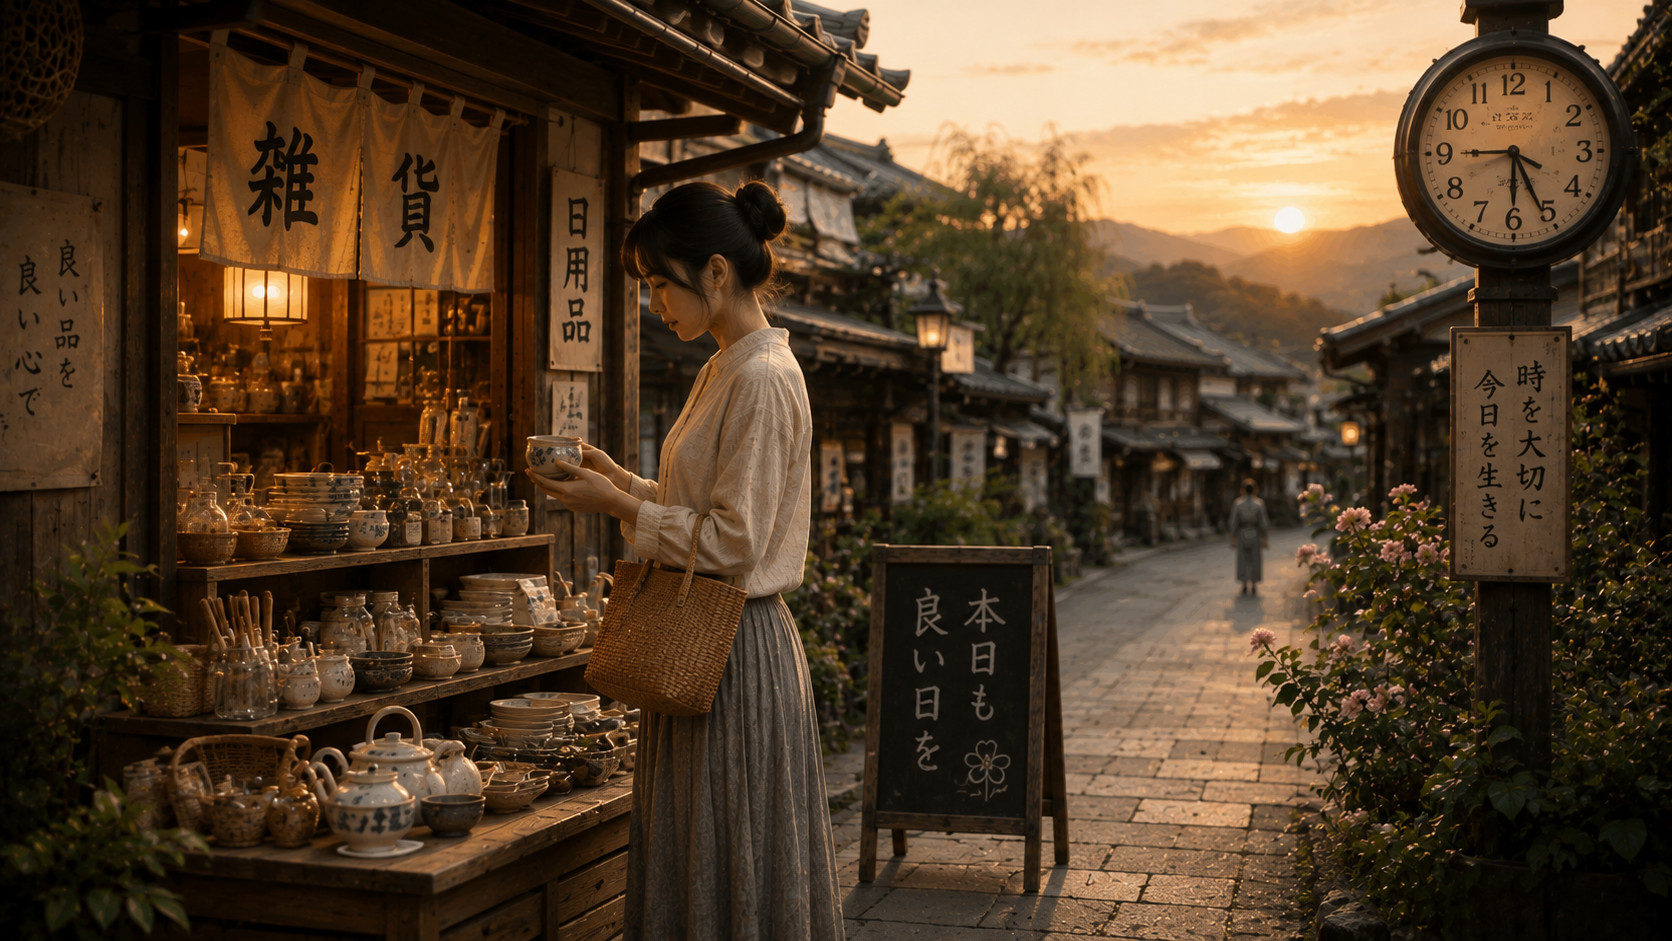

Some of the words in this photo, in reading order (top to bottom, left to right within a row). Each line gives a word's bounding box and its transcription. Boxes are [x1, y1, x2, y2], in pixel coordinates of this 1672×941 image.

[1471, 82, 1488, 104] 11
[1502, 72, 1526, 96] 12
[1545, 80, 1552, 103] 1
[1445, 108, 1469, 131] 10
[1565, 104, 1582, 127] 2
[1436, 142, 1453, 165] 9
[1576, 140, 1592, 163] 3
[248, 121, 440, 253] 雑貨
[1446, 176, 1464, 200] 8
[1564, 175, 1582, 197] 4
[1473, 200, 1489, 223] 7
[1505, 207, 1522, 230] 6
[1540, 200, 1556, 222] 5
[562, 197, 592, 344] 日用品
[54, 239, 81, 389] 良い品を
[15, 255, 42, 416] 良い心で
[1516, 360, 1546, 522] 時を大切に
[1474, 369, 1506, 548] 今日を生きる
[964, 587, 1007, 721] 本日も
[913, 587, 949, 772] 良い日を
